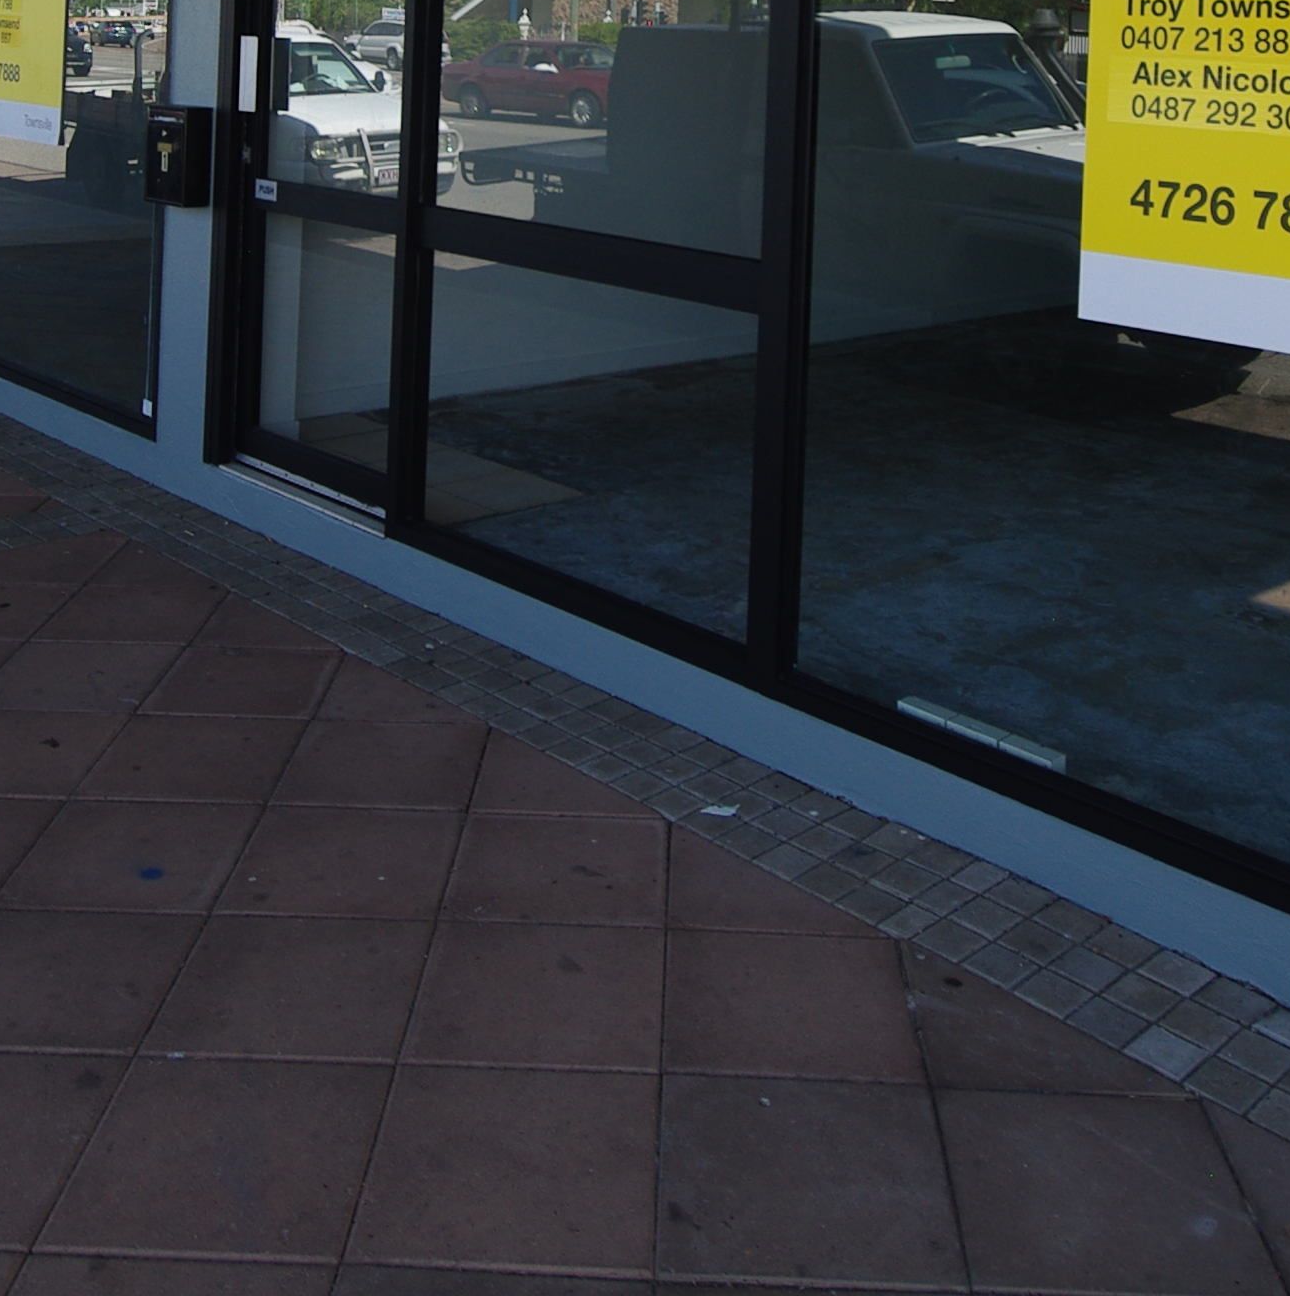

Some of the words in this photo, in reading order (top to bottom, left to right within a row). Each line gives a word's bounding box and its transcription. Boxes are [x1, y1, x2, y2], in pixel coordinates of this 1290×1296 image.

[1121, 25, 1185, 51] 0407
[1194, 27, 1245, 53] 213
[1132, 61, 1192, 88] Alex
[1131, 94, 1196, 122] 0487
[1206, 100, 1257, 127] 292
[1130, 179, 1236, 226] 4726
